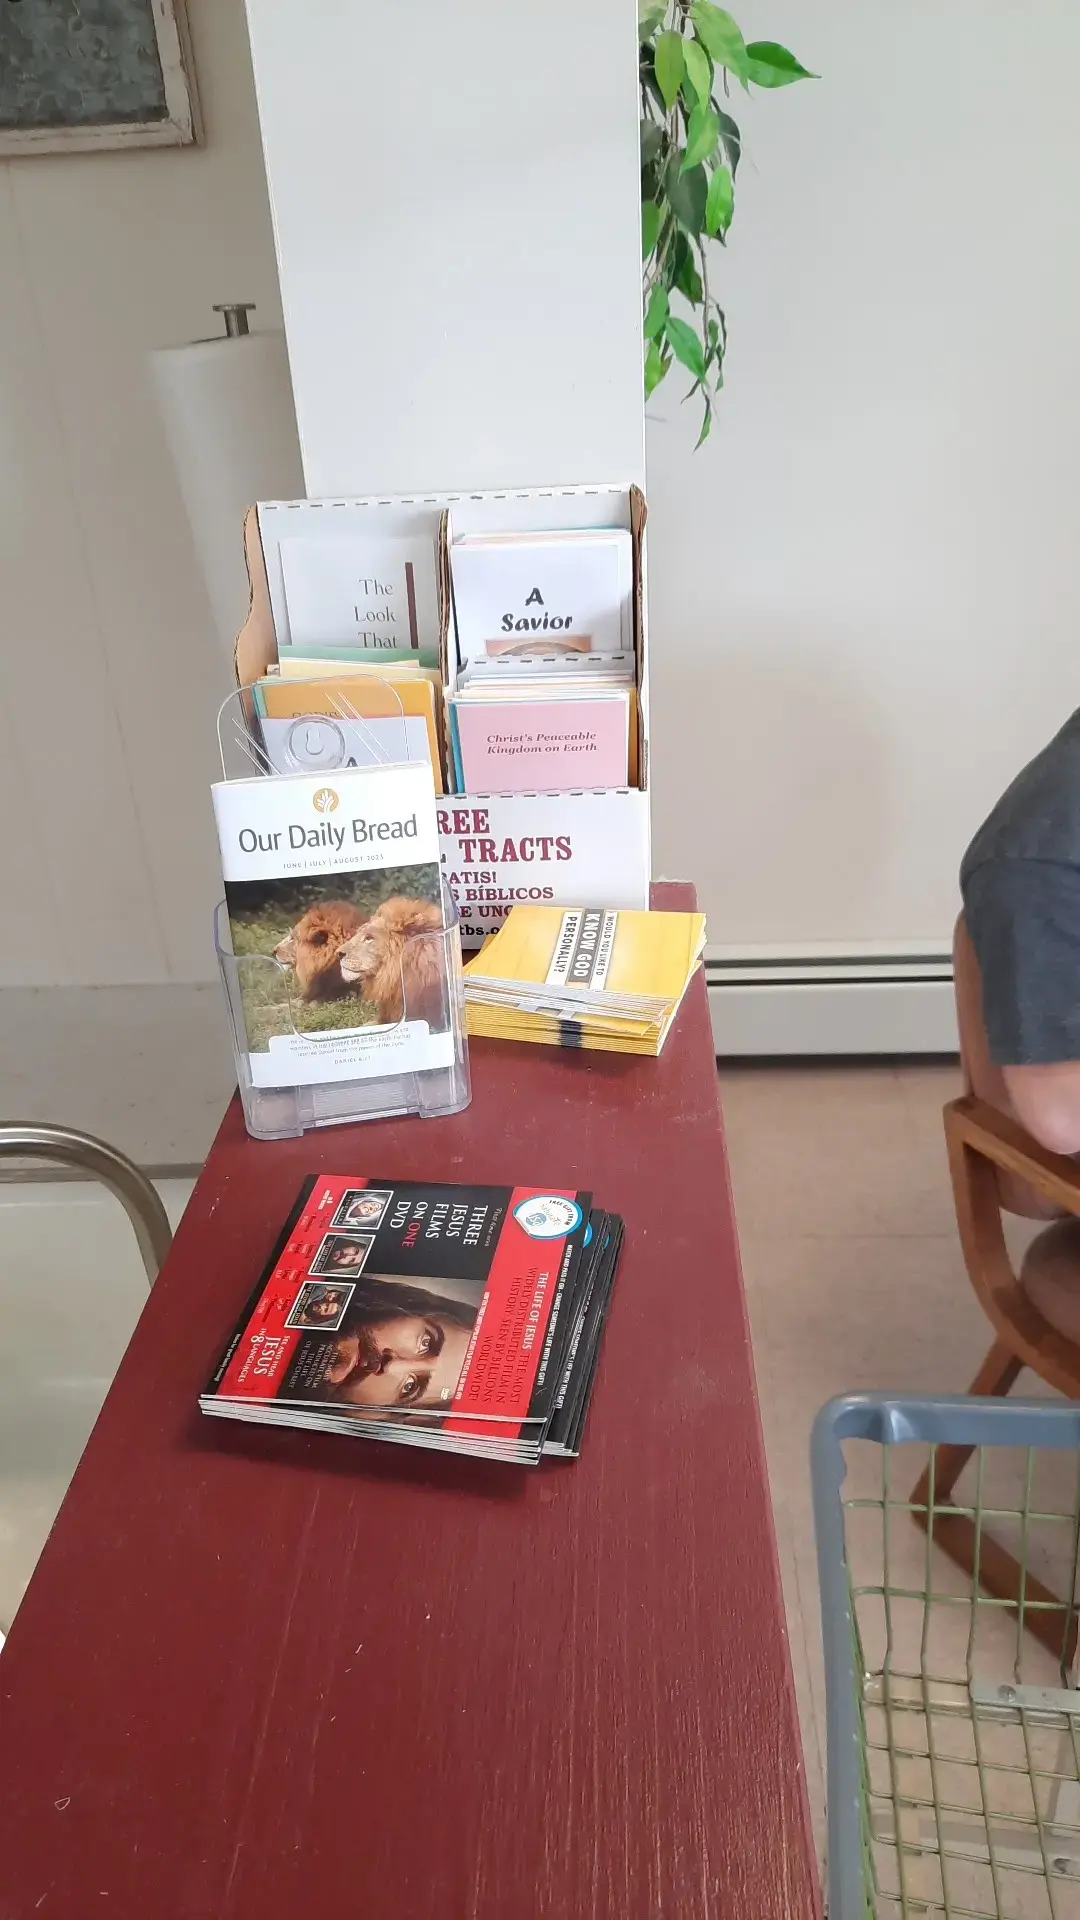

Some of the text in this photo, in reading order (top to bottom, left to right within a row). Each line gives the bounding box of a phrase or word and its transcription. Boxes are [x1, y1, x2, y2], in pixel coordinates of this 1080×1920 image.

[359, 579, 394, 596] The
[525, 587, 544, 606] A
[353, 606, 396, 622] Look
[501, 611, 573, 632] Savior
[357, 632, 398, 648] That
[487, 731, 597, 743] Christ's Peaceable
[487, 745, 542, 756] Kingdom
[563, 743, 598, 752] Earth
[436, 809, 490, 834] REE
[238, 813, 418, 853] Our Daily Bread
[458, 836, 573, 863] TRACTS
[333, 856, 363, 865] AUGUST
[441, 871, 497, 884] ATIS!
[465, 885, 554, 901] BÍBLICOS
[553, 916, 578, 973] PERSONALLY?
[573, 913, 601, 977] KNOW GOD
[595, 915, 615, 976] WOULD YOU LIKE TO
[388, 1200, 411, 1228] DVD
[401, 1201, 429, 1246] ON ONE
[424, 1203, 449, 1238] FILMS
[441, 1203, 468, 1236] JESUS
[462, 1204, 488, 1245] THREE
[554, 1293, 562, 1310] CHANGE
[248, 1335, 265, 1343] 8
[481, 1277, 522, 1402] HISTORY SEEN BY BILLIONS
[495, 1267, 537, 1403] WIDELY DISTRIBUTED FILM IN
[509, 1271, 549, 1403] THE LIFE OF JESUS THE MOST
[545, 1337, 553, 1346] LIFE
[236, 1343, 260, 1382] LANGUAGES
[249, 1336, 281, 1374] JESUS
[274, 1345, 285, 1359] AND
[542, 1348, 550, 1360] WITH
[266, 1360, 279, 1376] HEAR
[467, 1335, 493, 1400] WORLDWIDE!
[540, 1361, 548, 1371] THIS
[537, 1372, 545, 1385] GIFT!
